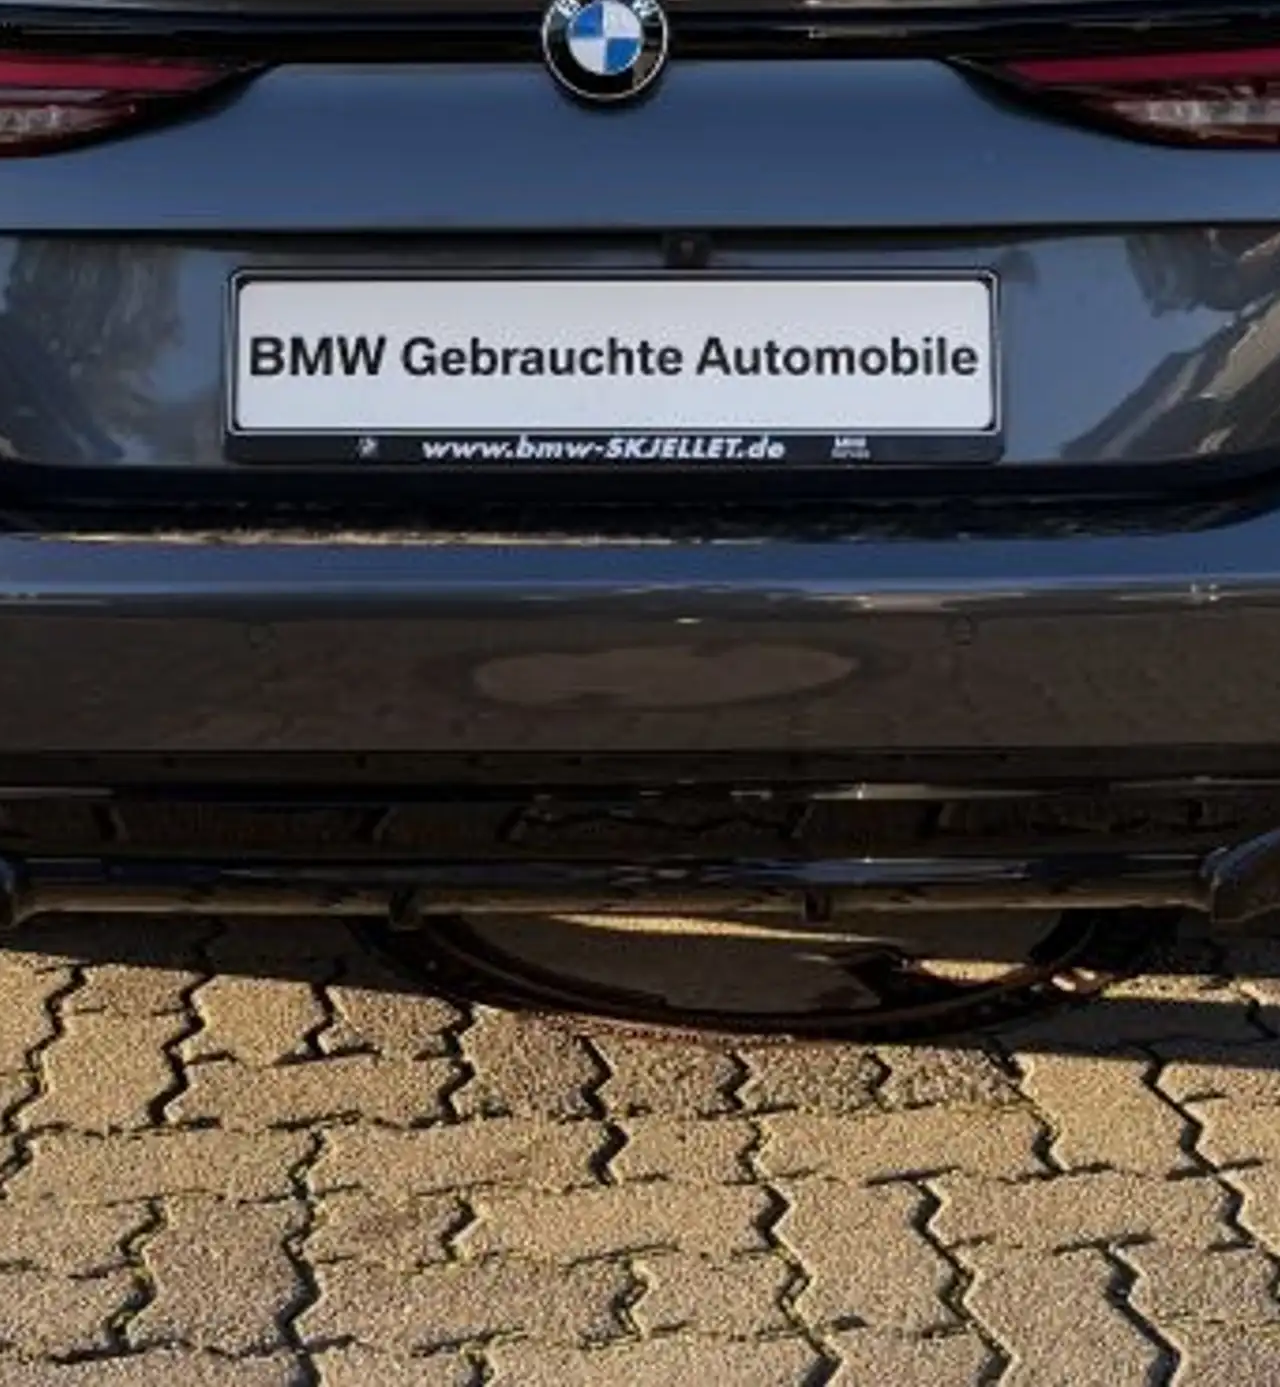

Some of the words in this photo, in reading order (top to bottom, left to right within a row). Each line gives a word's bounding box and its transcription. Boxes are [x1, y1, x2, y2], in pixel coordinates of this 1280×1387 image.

[249, 335, 387, 377] BMW
[401, 335, 683, 377] Gebrauchte
[696, 335, 979, 377] Automobile
[421, 435, 785, 460] www.bmw-SKJELLET.de
